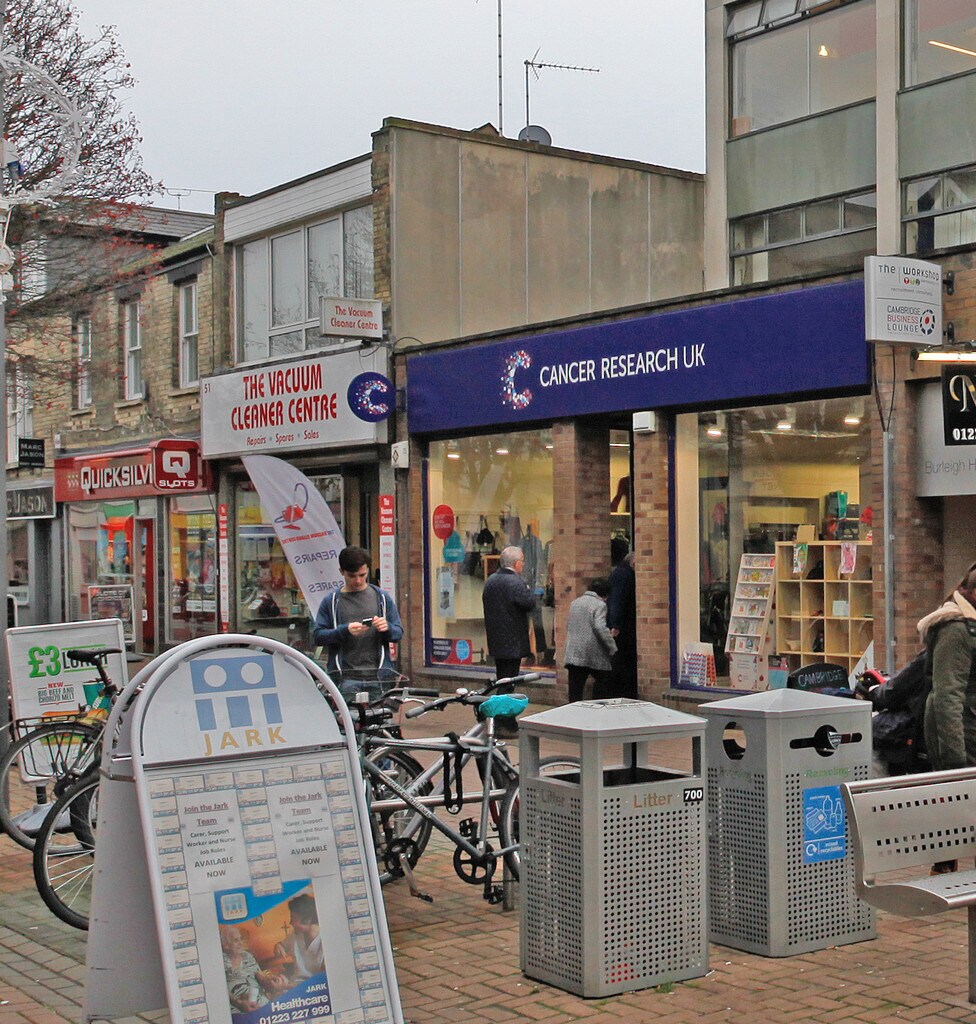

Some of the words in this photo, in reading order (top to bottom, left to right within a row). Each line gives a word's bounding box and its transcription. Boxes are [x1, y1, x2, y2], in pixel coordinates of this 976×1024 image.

[878, 265, 896, 274] The
[334, 305, 347, 315] The
[349, 306, 374, 318] Vacuum
[887, 304, 921, 316] CAMBRIDGE
[330, 317, 356, 329] Cleaner
[357, 318, 378, 331] Centre
[887, 314, 919, 324] BUSINESS
[887, 323, 919, 333] LOUNGE
[539, 359, 596, 387] CANCER
[601, 346, 678, 380] RESEARCH
[682, 343, 706, 369] UK
[242, 373, 265, 400] THE
[267, 363, 323, 397] VACUUM
[204, 382, 211, 394] 51
[230, 399, 284, 431] CLEANER
[288, 392, 337, 424] CENTRE
[246, 435, 267, 446] Repairs
[275, 433, 294, 445] Spares
[304, 429, 319, 440] Sales
[162, 450, 191, 478] Q
[925, 460, 966, 475] Burleigh
[158, 479, 195, 488] SLOTS
[27, 645, 62, 678] £3
[798, 669, 842, 688] CAMBRIDGE
[61, 693, 75, 701] MELT
[203, 726, 287, 757] JARK
[278, 795, 295, 805] Join
[296, 794, 308, 802] the
[308, 792, 323, 801] Jark
[684, 788, 703, 800] 700
[633, 792, 673, 810] Litter
[184, 804, 199, 814] Join
[201, 805, 212, 813] the
[213, 802, 229, 812] Jark
[291, 806, 312, 816] Team
[196, 816, 218, 825] Team
[301, 817, 324, 826] Support
[207, 828, 230, 837] Support
[290, 844, 328, 856] AVAILABLE
[194, 856, 234, 868] AVAILABLE
[301, 857, 321, 866] NOW
[206, 869, 227, 879] NOW
[305, 983, 327, 993] JARK
[271, 994, 329, 1013] Healthcare
[259, 1012, 290, 1024] 01223
[291, 1009, 310, 1020] 227
[312, 1005, 331, 1015] 999
